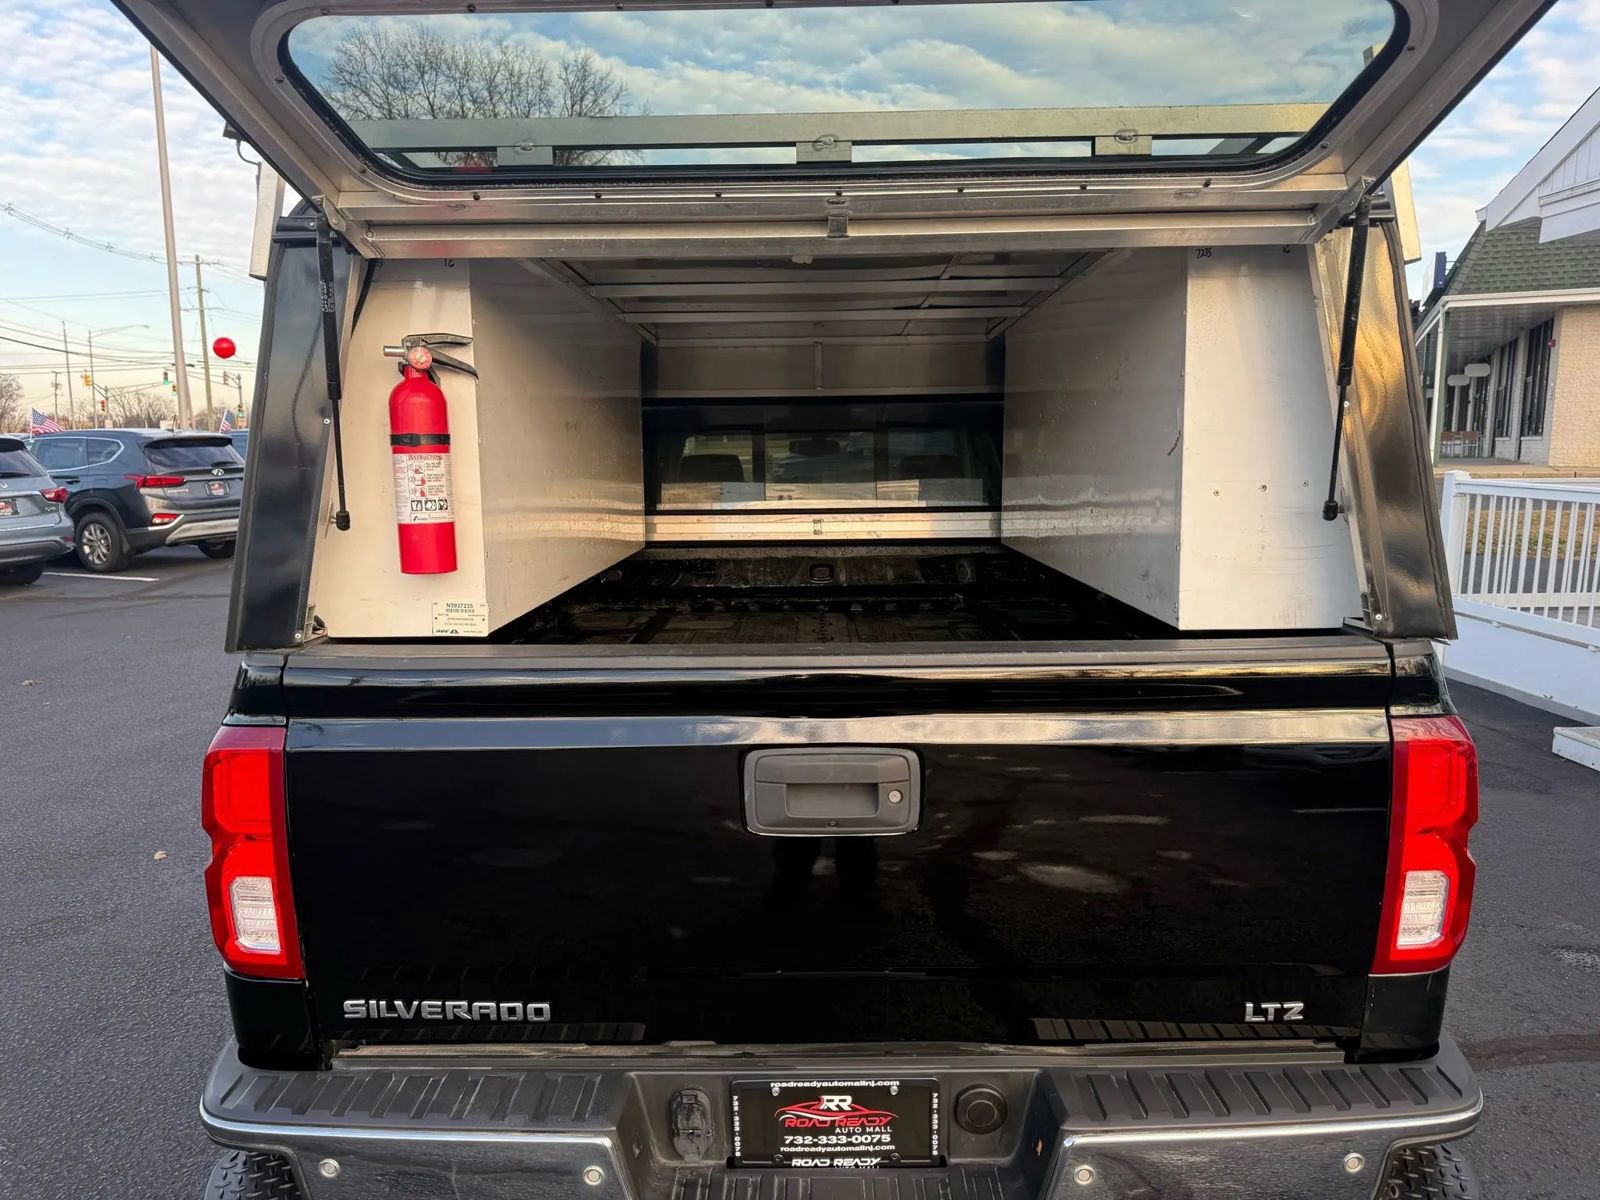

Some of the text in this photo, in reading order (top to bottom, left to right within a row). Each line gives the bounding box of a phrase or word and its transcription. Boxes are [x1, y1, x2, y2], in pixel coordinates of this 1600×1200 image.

[343, 999, 551, 1022] SILVERADO
[1244, 1001, 1304, 1022] LTZ
[770, 1080, 900, 1089] roadreadyautomallnj.com
[819, 1095, 853, 1111] RR
[784, 1116, 893, 1128] ROAD READY
[835, 1126, 862, 1134] AUTO
[783, 1134, 891, 1144] 732-333-0075
[780, 1145, 896, 1153] roadreadyautomallnj.com
[791, 1157, 881, 1167] ROAD READY
